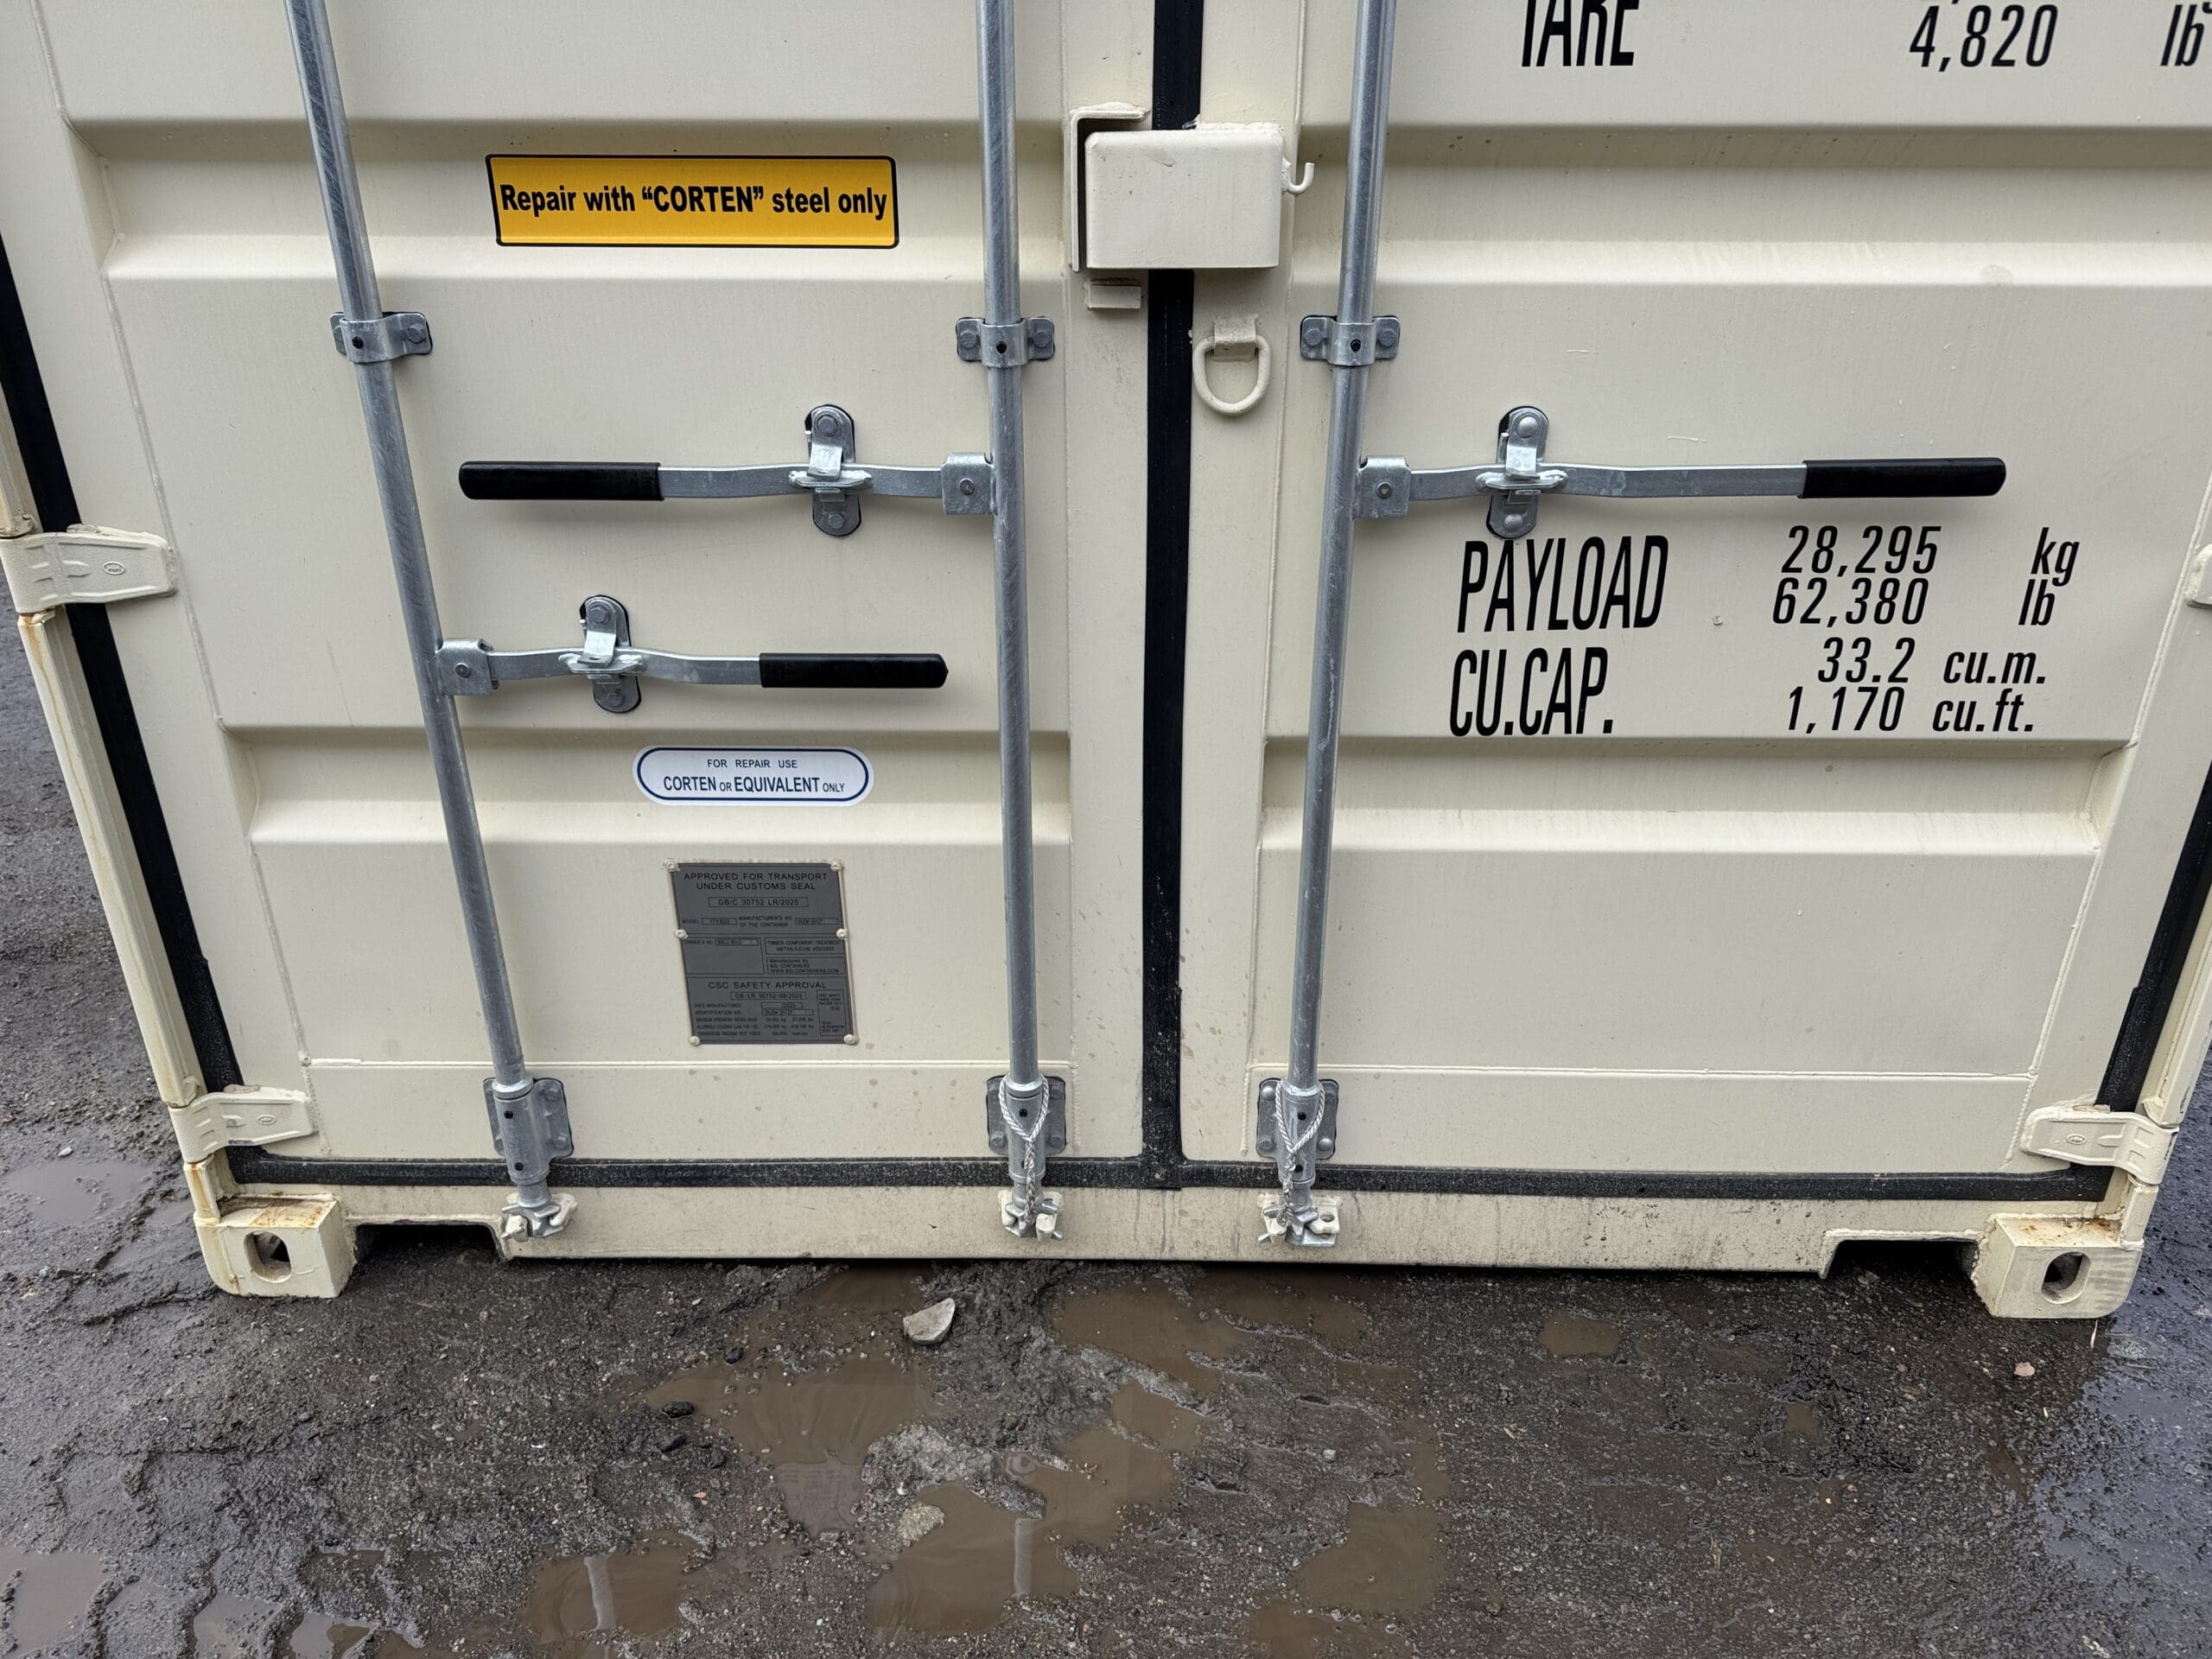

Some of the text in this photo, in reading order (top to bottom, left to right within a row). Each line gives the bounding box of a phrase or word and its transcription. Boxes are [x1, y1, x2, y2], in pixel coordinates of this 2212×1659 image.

[1910, 3, 2206, 73] 4,820 lb
[499, 184, 887, 220] Repair with “CORTEN” steel only
[1457, 525, 2080, 633] PAYLOAD 28,295 kg
[1772, 578, 2056, 628] 62,380 lb
[1450, 637, 2049, 737] CU.CAP. 33.2 cu.m.
[1788, 686, 2035, 734] 1,170 cu.ft.
[664, 776, 845, 792] CORTEN OR EQUIVALENT ONLY
[707, 760, 798, 768] FOR REPAIR USE
